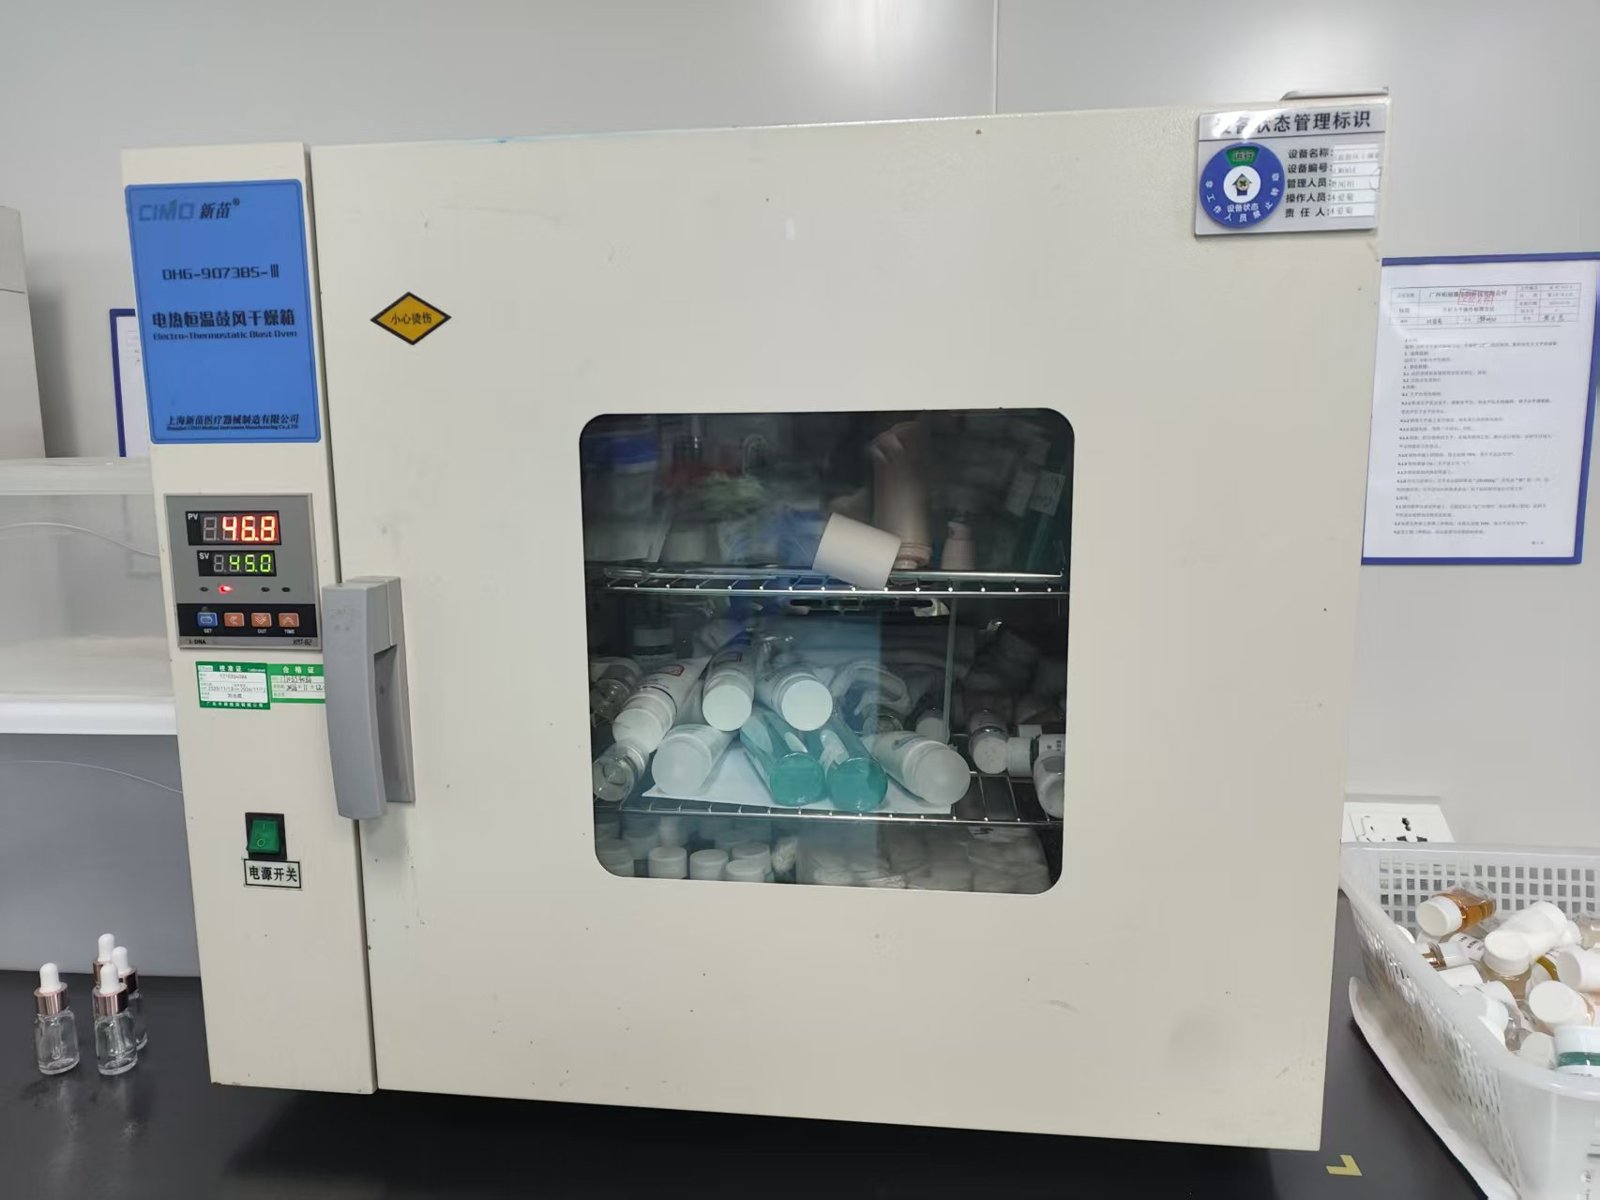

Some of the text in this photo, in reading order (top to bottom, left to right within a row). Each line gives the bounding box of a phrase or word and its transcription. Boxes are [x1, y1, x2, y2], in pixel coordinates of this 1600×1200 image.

[139, 200, 195, 221] CIMO
[152, 308, 296, 329] 电热恒温鼓风干燥箱
[391, 312, 432, 325] 小心烫伤
[187, 513, 199, 521] PV
[222, 516, 276, 542] 46.8
[199, 552, 210, 560] SV
[229, 554, 272, 573] 45.0
[282, 665, 315, 674] 合格证
[249, 865, 298, 882] 电源开关
